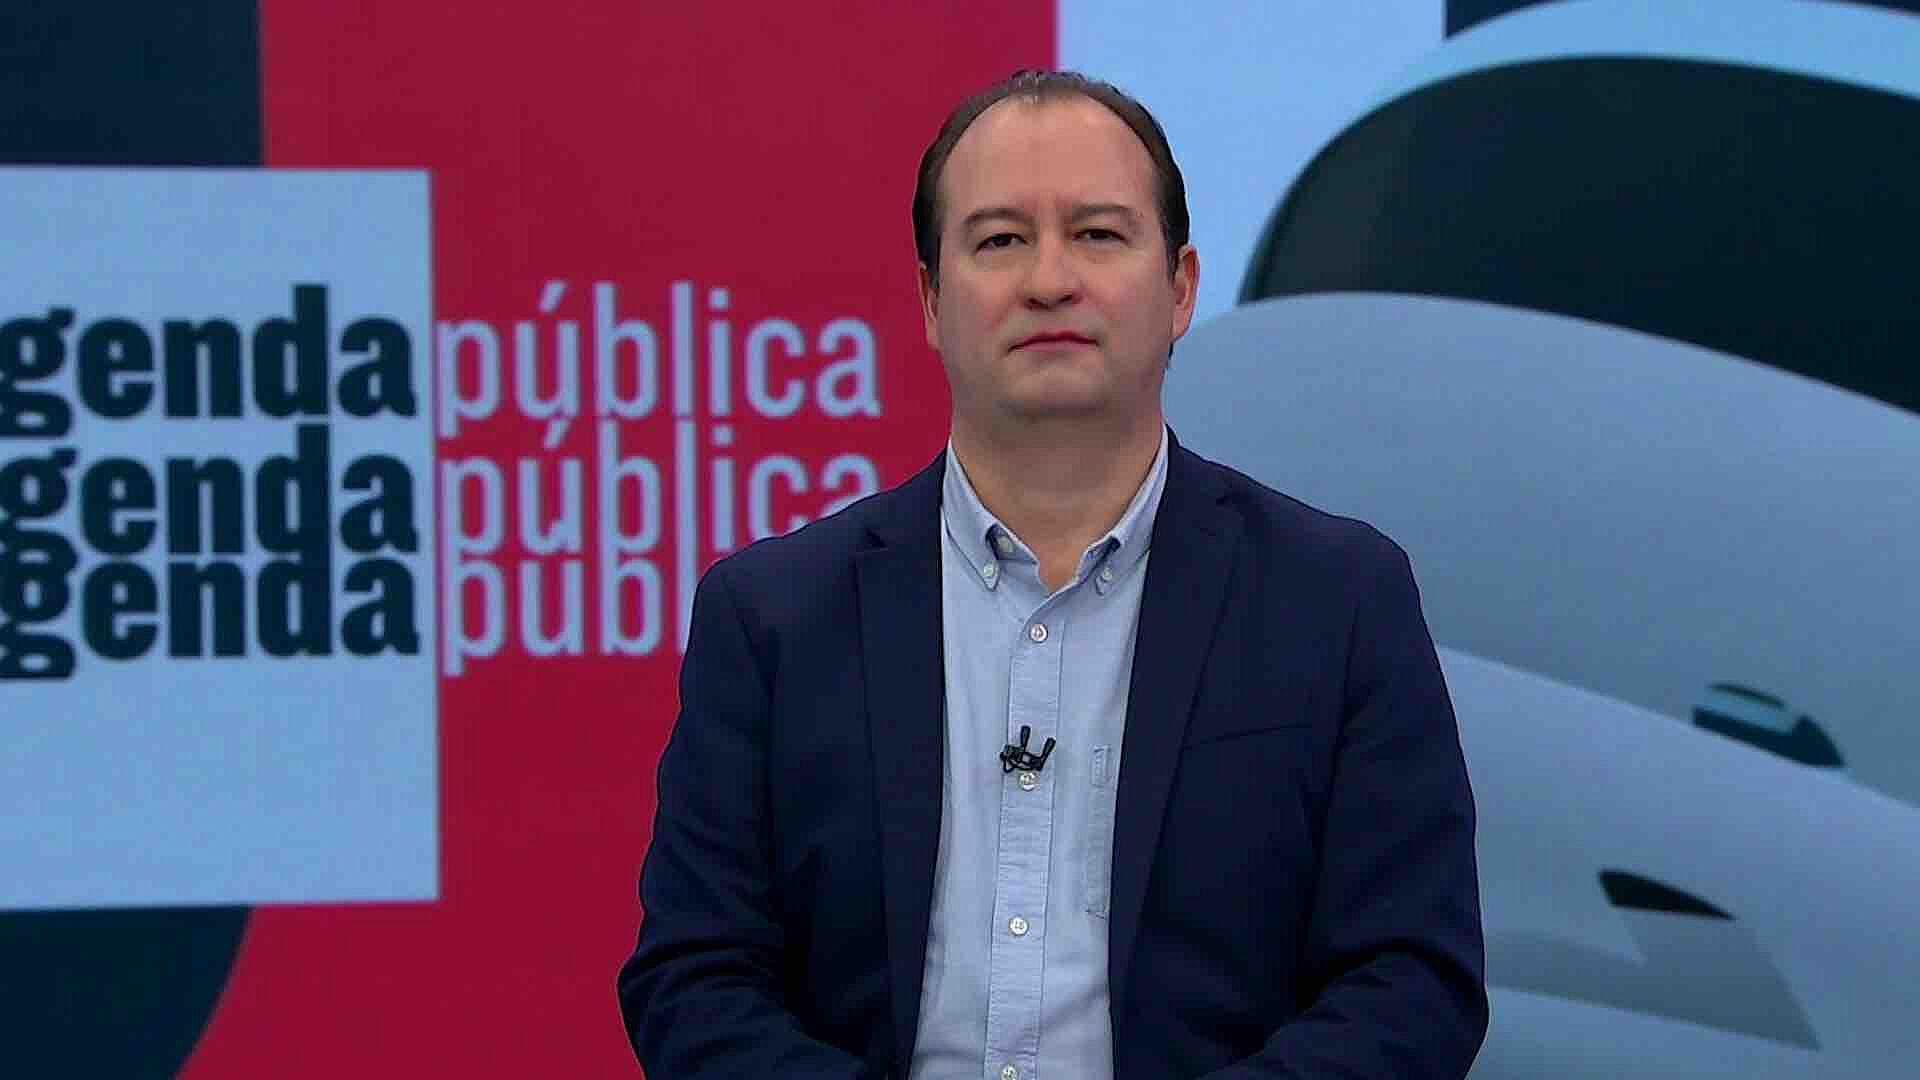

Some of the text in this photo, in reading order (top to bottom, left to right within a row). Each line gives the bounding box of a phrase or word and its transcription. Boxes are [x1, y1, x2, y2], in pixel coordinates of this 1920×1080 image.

[0, 281, 884, 439] genda pública
[0, 424, 419, 568] genda
[0, 548, 420, 680] genda
